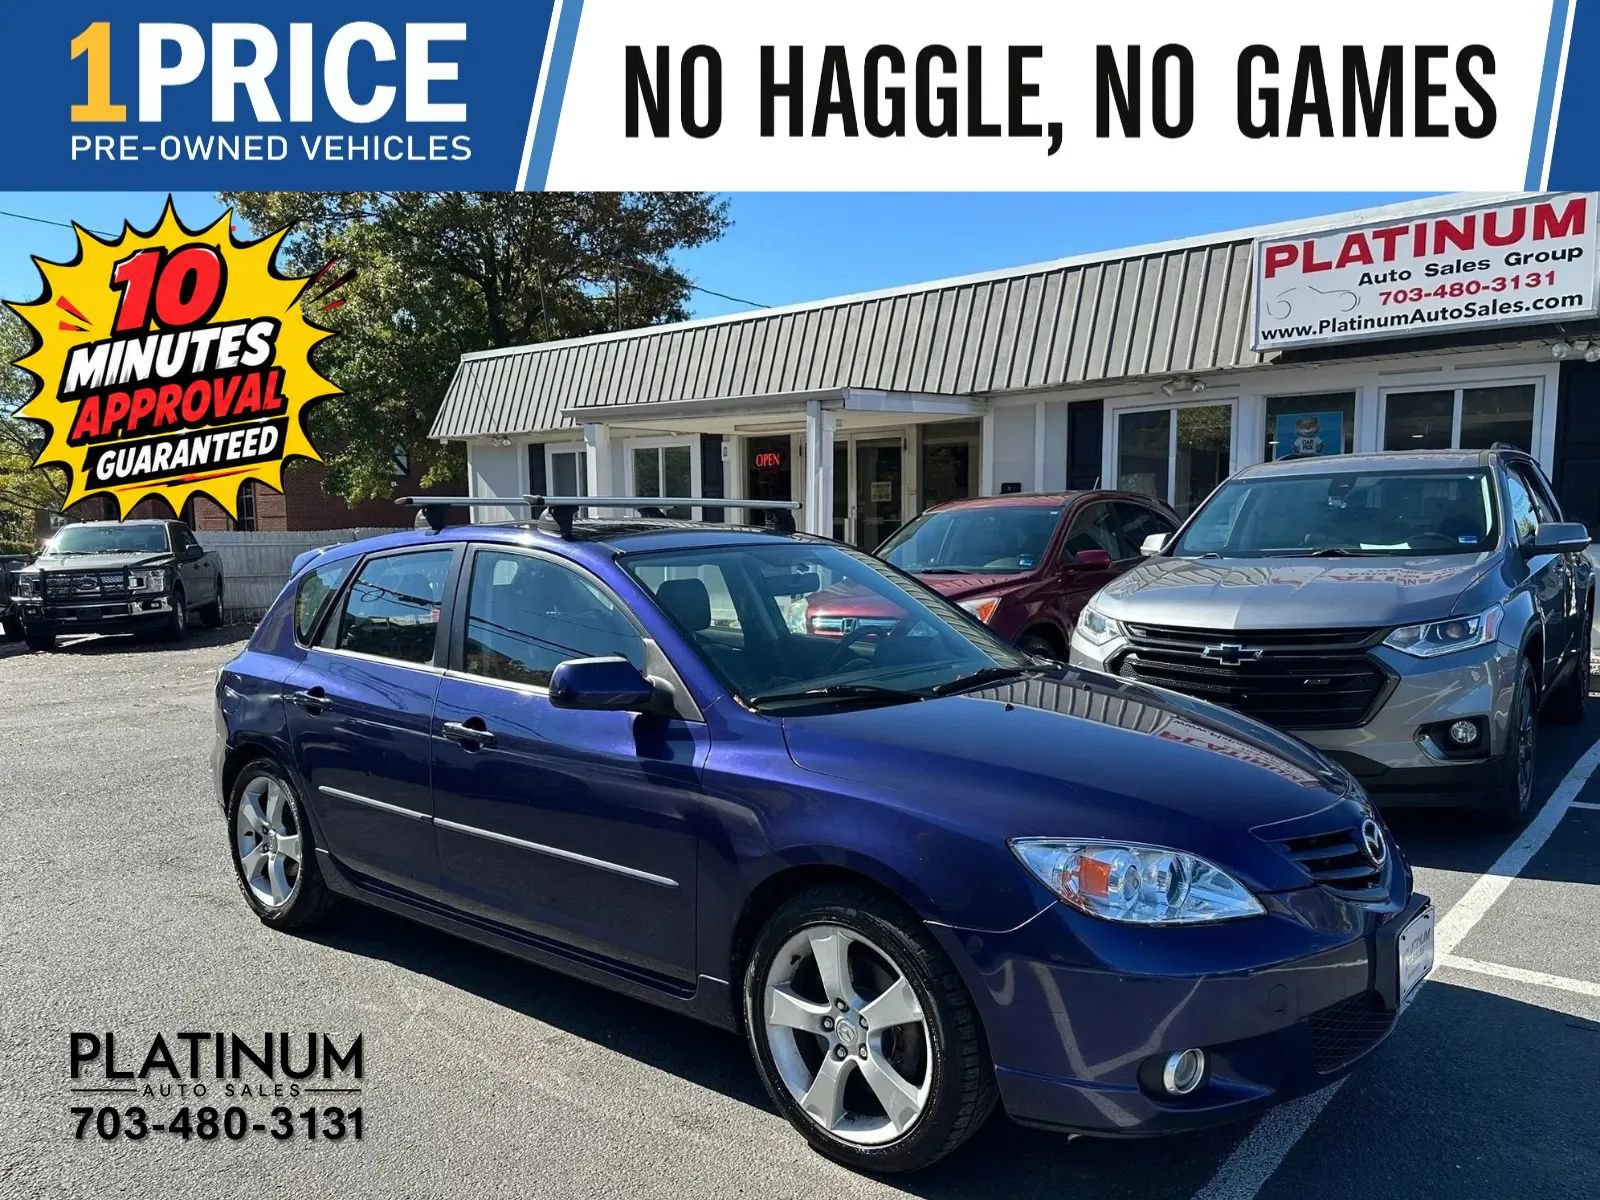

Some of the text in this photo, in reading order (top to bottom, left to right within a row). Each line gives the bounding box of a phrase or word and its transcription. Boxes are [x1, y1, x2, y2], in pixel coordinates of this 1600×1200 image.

[1264, 198, 1586, 279] PLATINUM
[1358, 246, 1584, 286] Auto Sales Group
[1379, 270, 1556, 306] 703-480-3131
[1261, 292, 1584, 341] www.PlatinumAutoSales.com
[755, 452, 781, 467] OPEN
